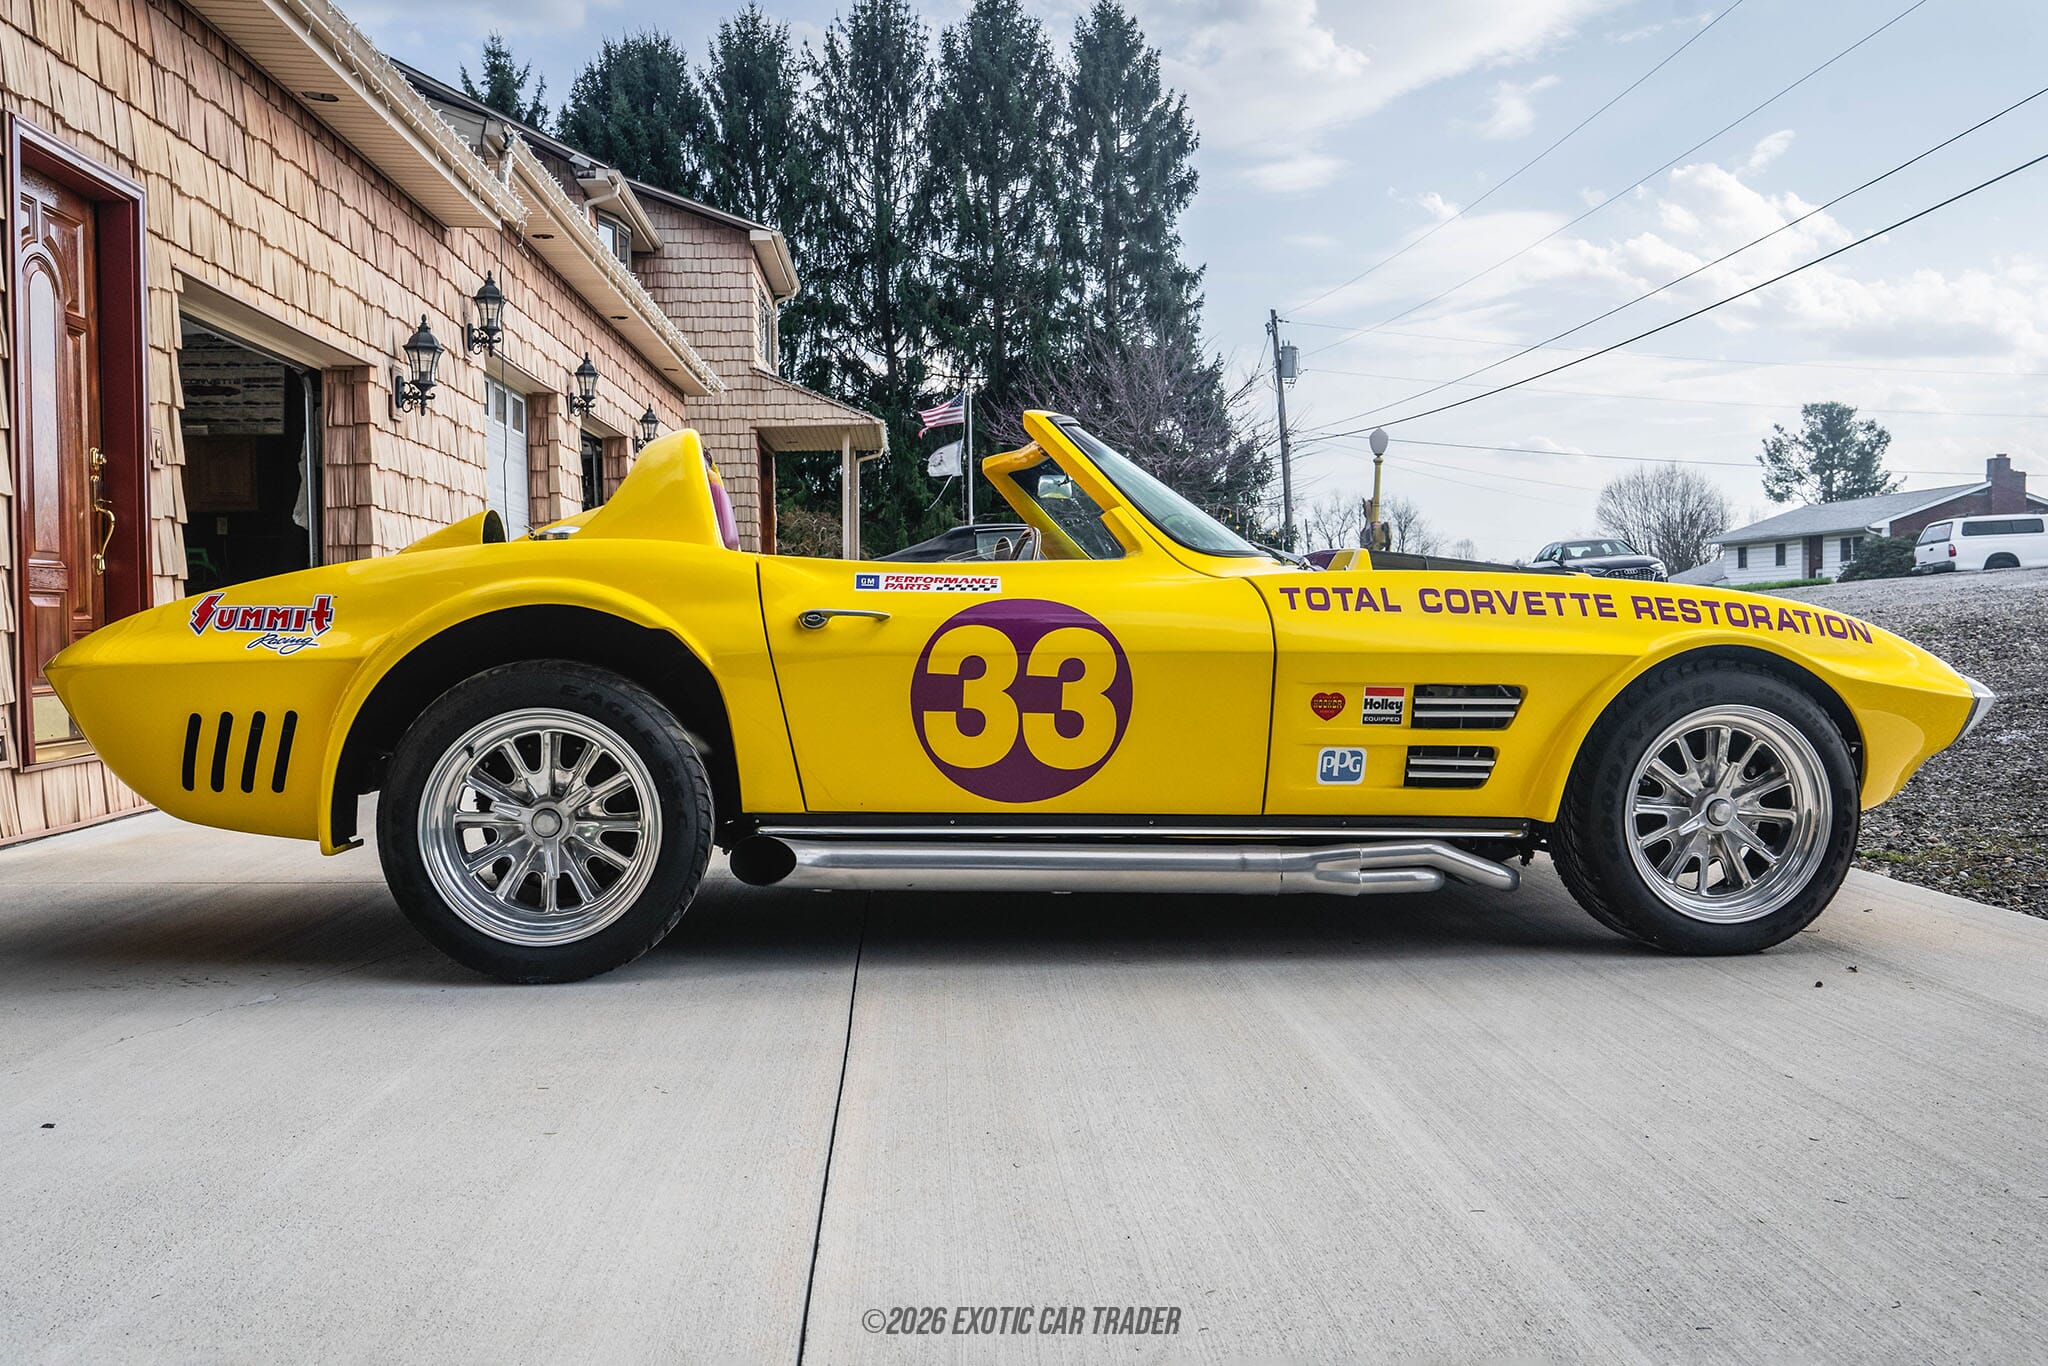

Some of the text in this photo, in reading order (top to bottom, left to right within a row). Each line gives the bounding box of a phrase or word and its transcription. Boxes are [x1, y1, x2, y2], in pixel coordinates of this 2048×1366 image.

[860, 578, 875, 586] GM
[884, 575, 999, 585] PERFORMANCE
[884, 583, 931, 591] PARTS
[1279, 587, 1873, 644] TOTAL CORVETTE RESTORATION
[246, 632, 319, 655] Racing
[923, 624, 1118, 771] 33
[1363, 698, 1403, 713] Holley
[1322, 750, 1361, 776] PPG
